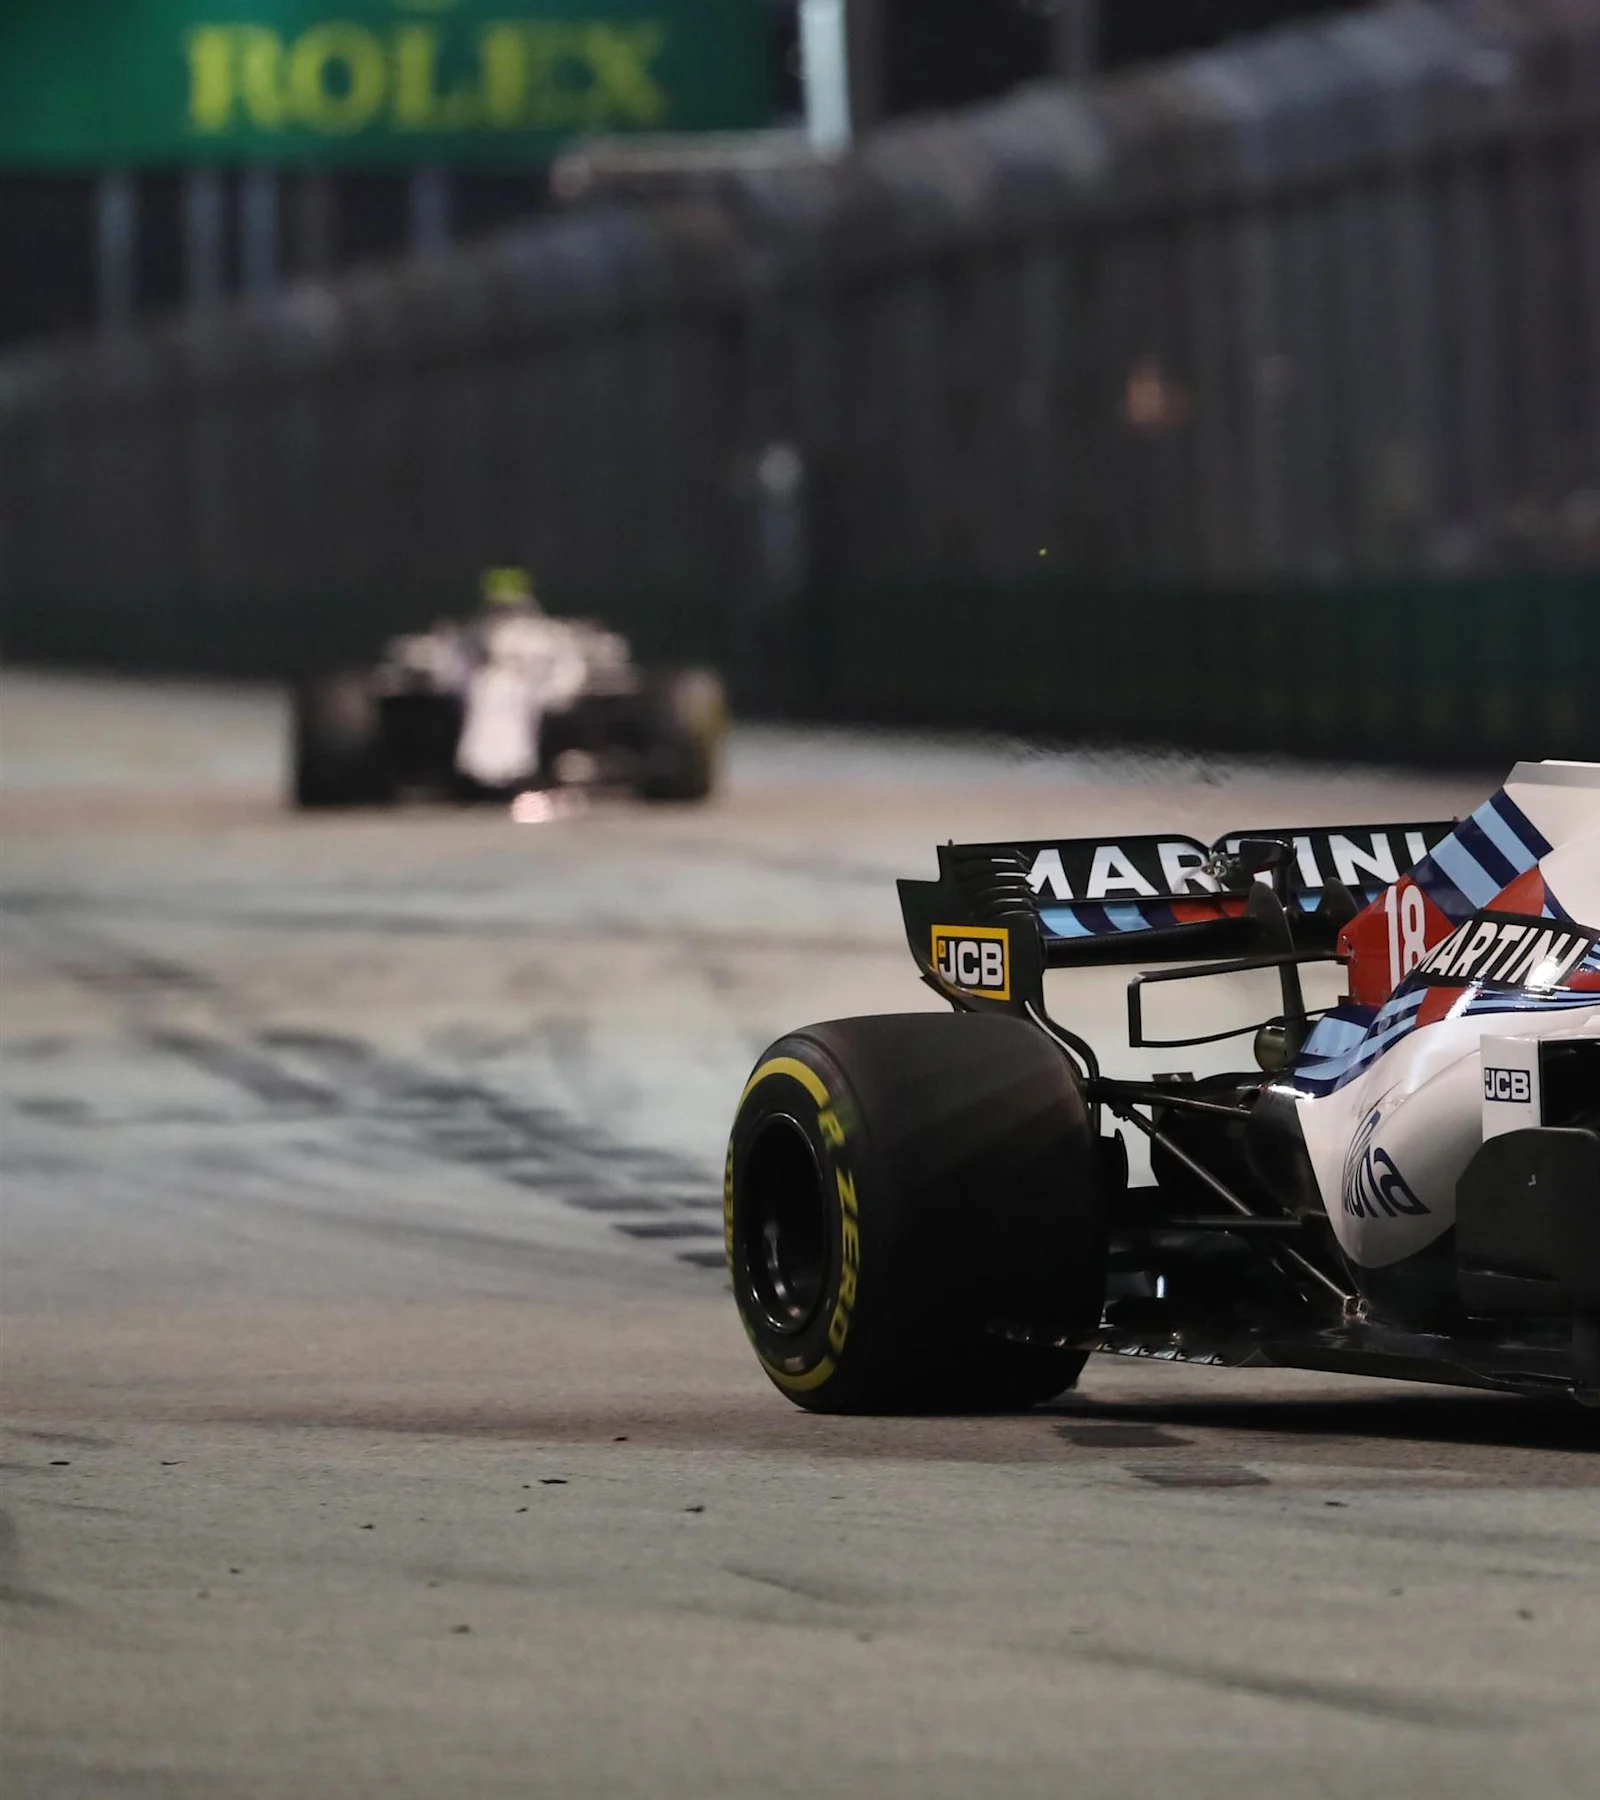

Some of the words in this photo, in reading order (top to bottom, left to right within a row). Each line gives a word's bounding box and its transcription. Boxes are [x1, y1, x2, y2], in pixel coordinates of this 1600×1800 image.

[188, 20, 665, 135] ROLEX
[938, 940, 1004, 986] JCB
[1384, 884, 1426, 993] 18
[1412, 919, 1590, 986] MARTINI
[1484, 1069, 1530, 1101] JCB
